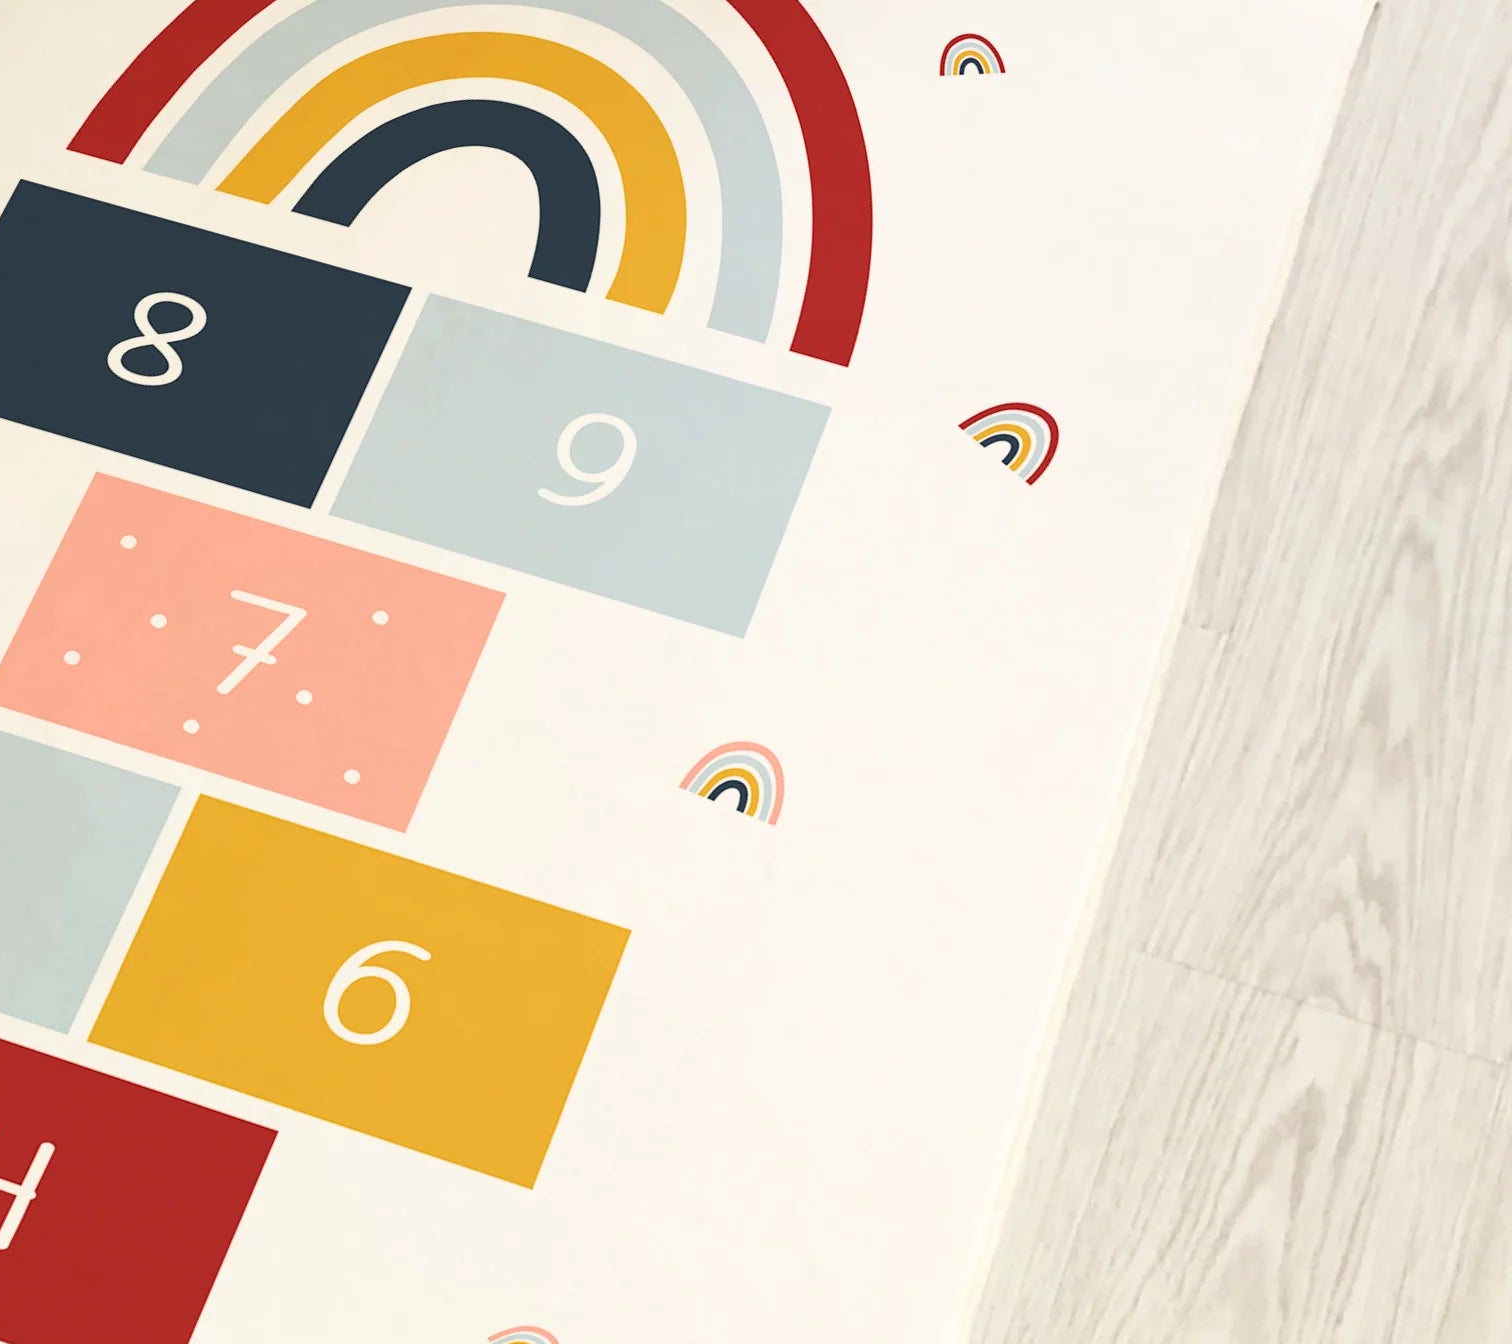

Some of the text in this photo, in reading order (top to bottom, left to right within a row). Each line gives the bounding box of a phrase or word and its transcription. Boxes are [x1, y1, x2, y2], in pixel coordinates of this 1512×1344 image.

[108, 292, 206, 385] 8
[538, 413, 637, 505] 9
[217, 590, 308, 694] 7
[324, 941, 431, 1044] 6
